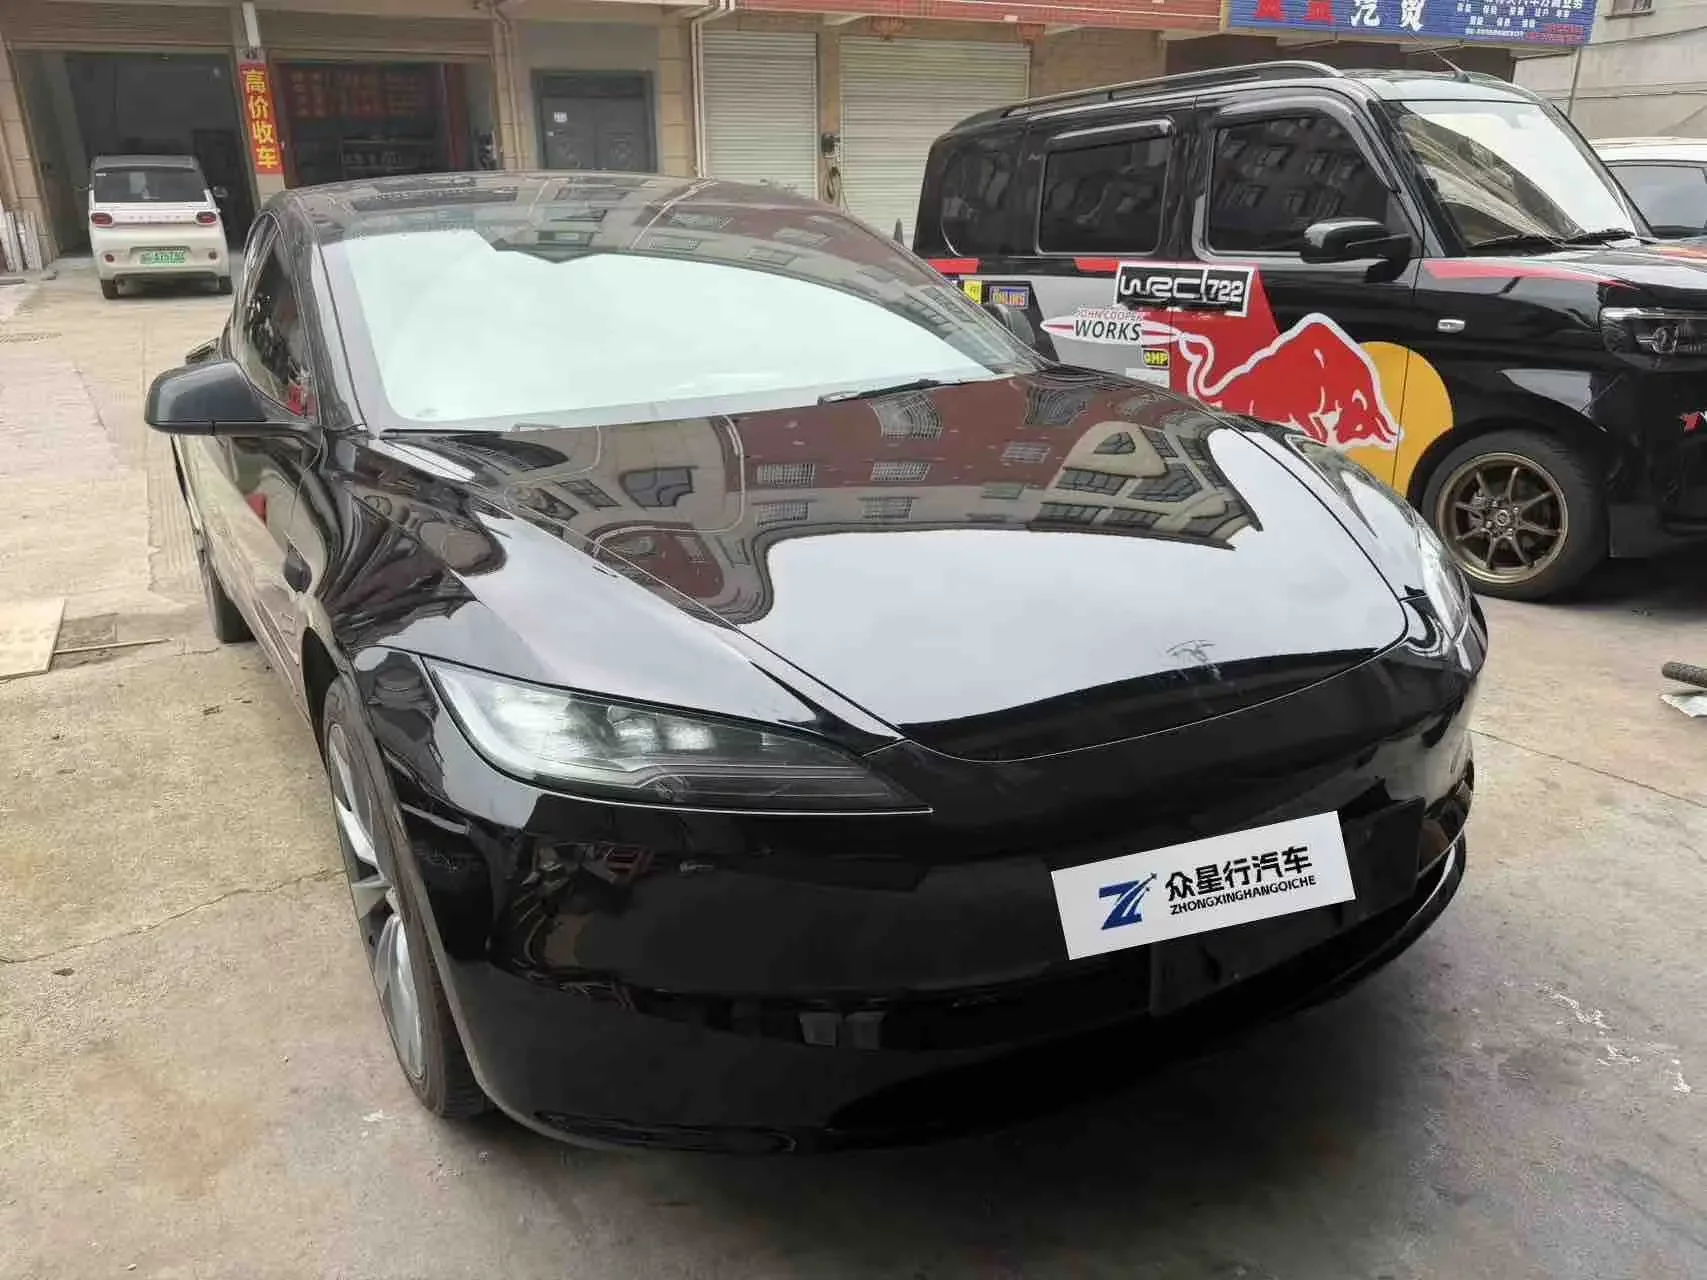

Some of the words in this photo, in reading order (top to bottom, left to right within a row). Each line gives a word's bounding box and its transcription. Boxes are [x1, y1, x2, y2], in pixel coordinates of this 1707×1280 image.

[243, 69, 279, 168] 高价收车
[1207, 279, 1244, 302] 722
[1075, 320, 1141, 341] WORKS
